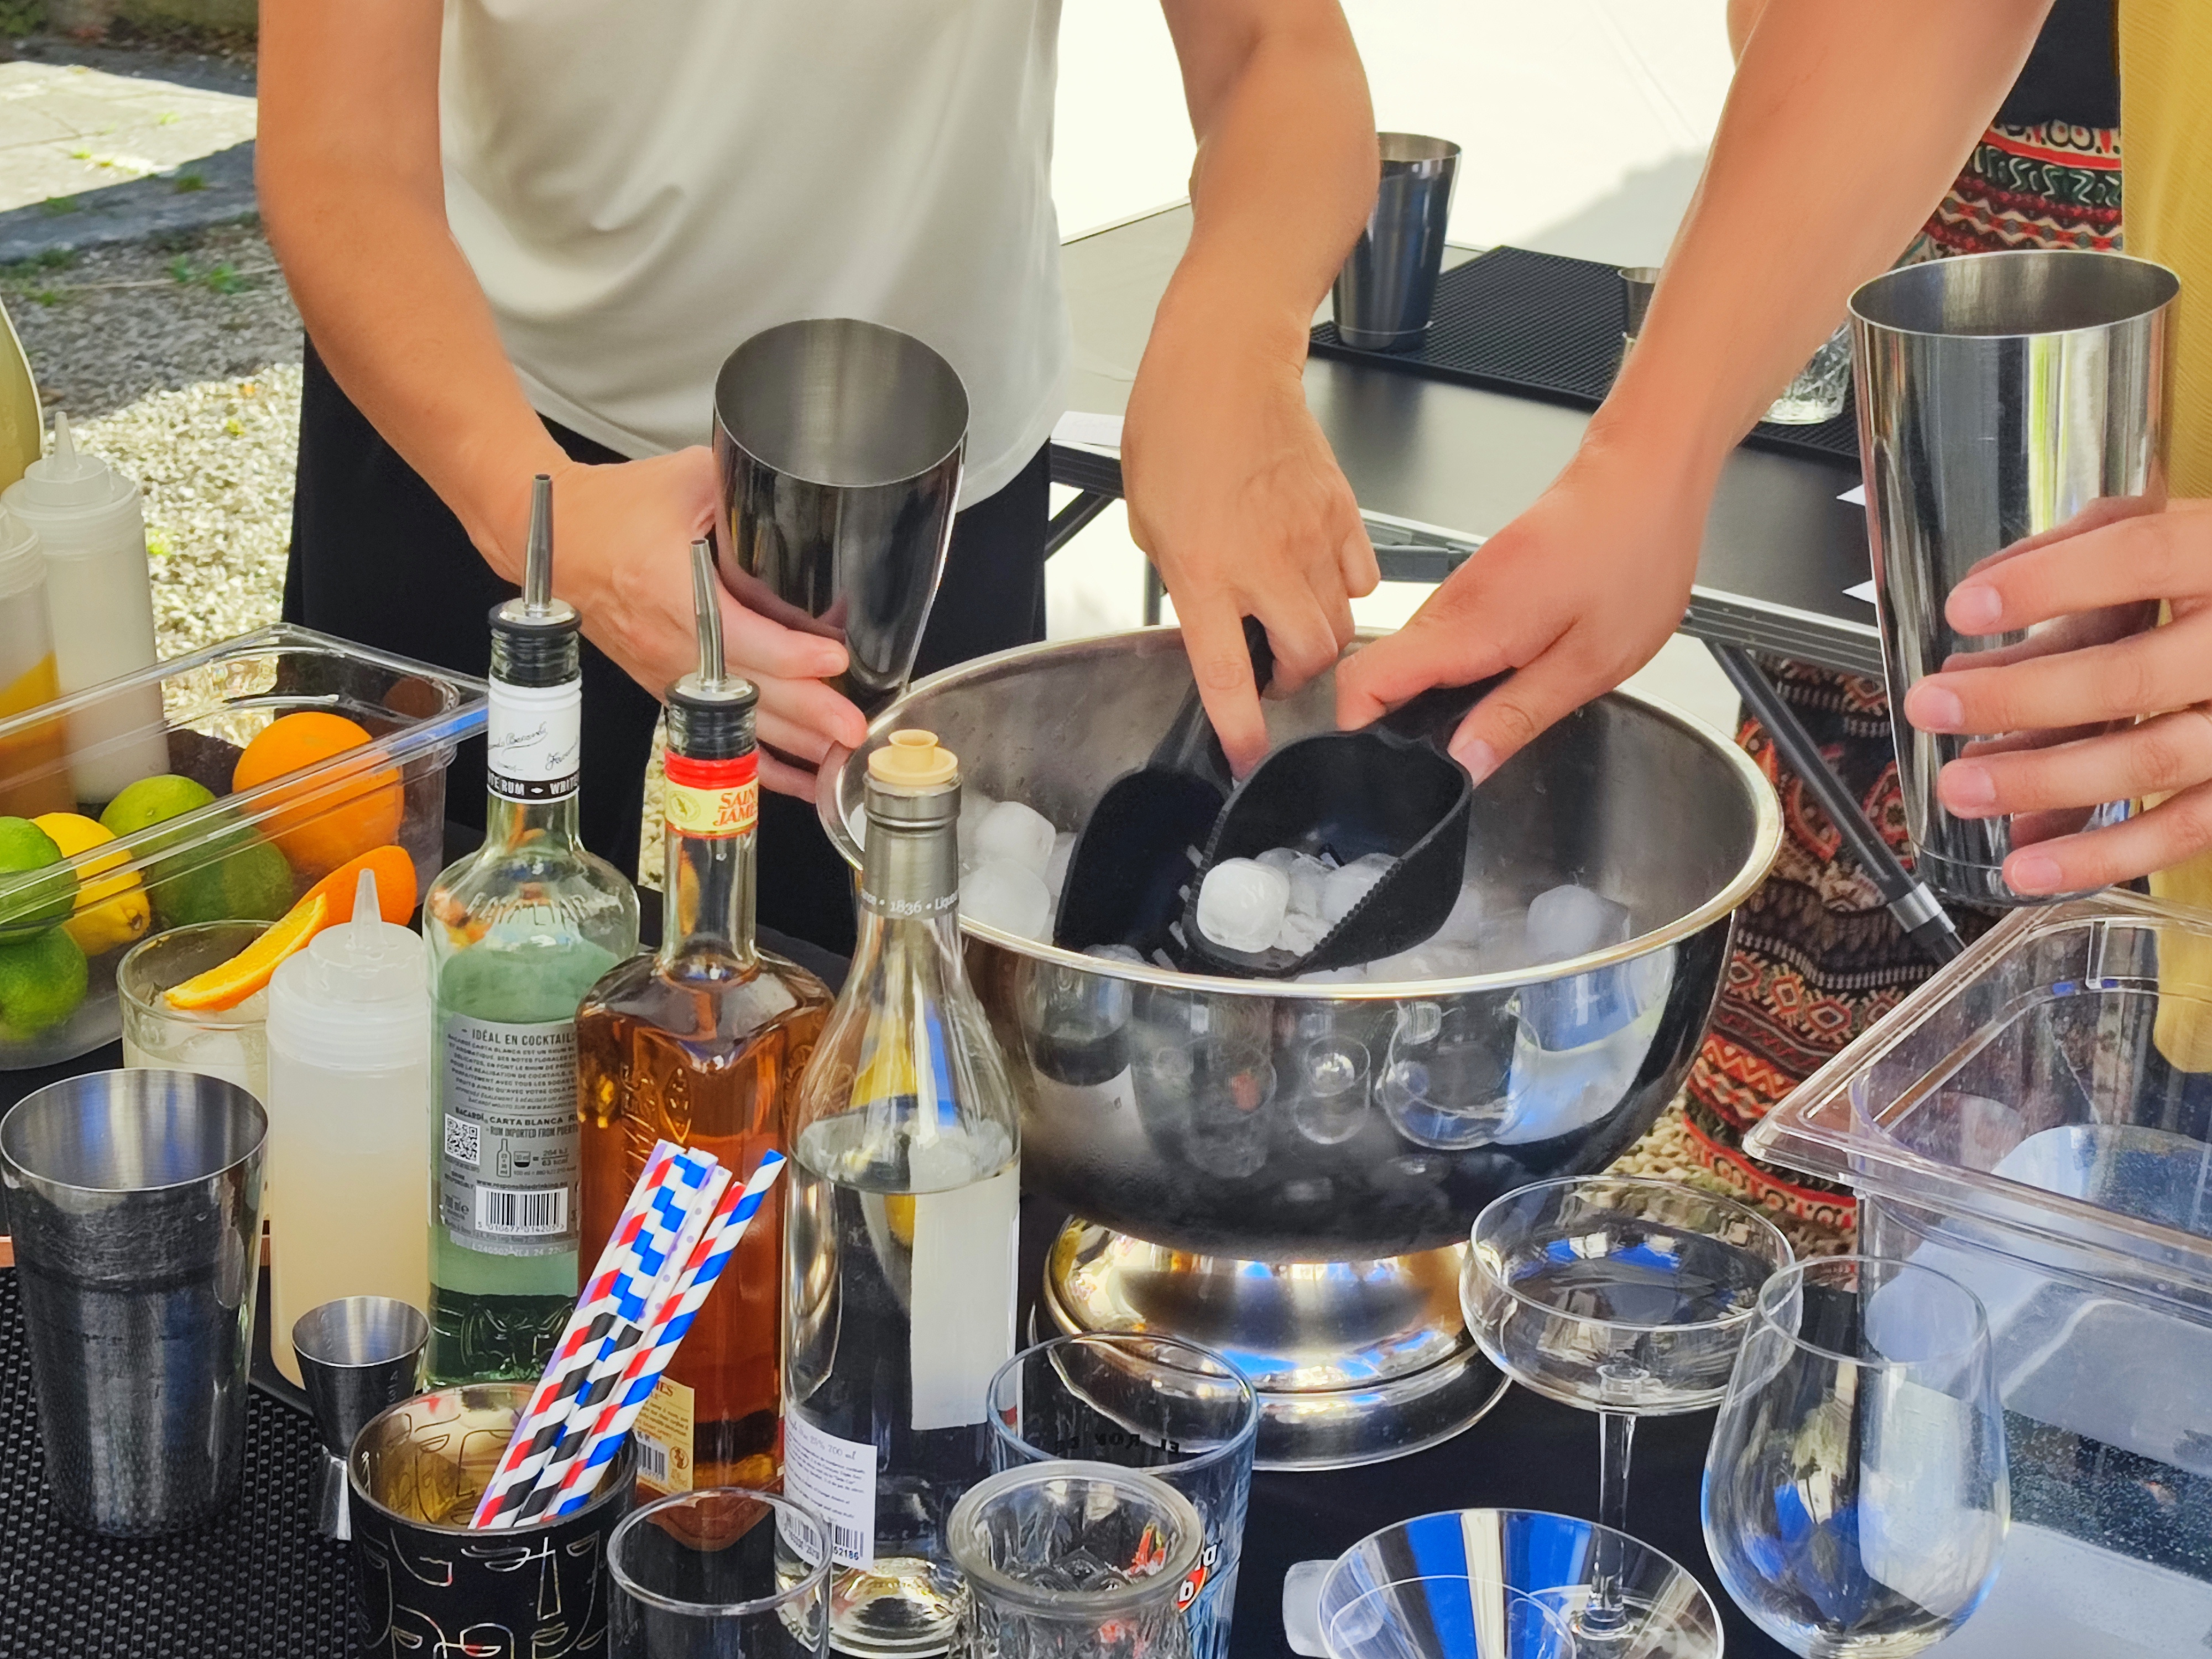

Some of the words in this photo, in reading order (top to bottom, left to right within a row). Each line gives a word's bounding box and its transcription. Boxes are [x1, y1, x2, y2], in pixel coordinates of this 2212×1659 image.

[501, 779, 525, 796] RUM
[717, 787, 758, 809] SAIN
[712, 803, 758, 826] JAME
[890, 899, 922, 916] 1836
[472, 1028, 502, 1044] IDÉAL
[505, 1034, 518, 1046] EN
[489, 1115, 523, 1126] CARTA
[524, 1116, 564, 1126] BLANCA
